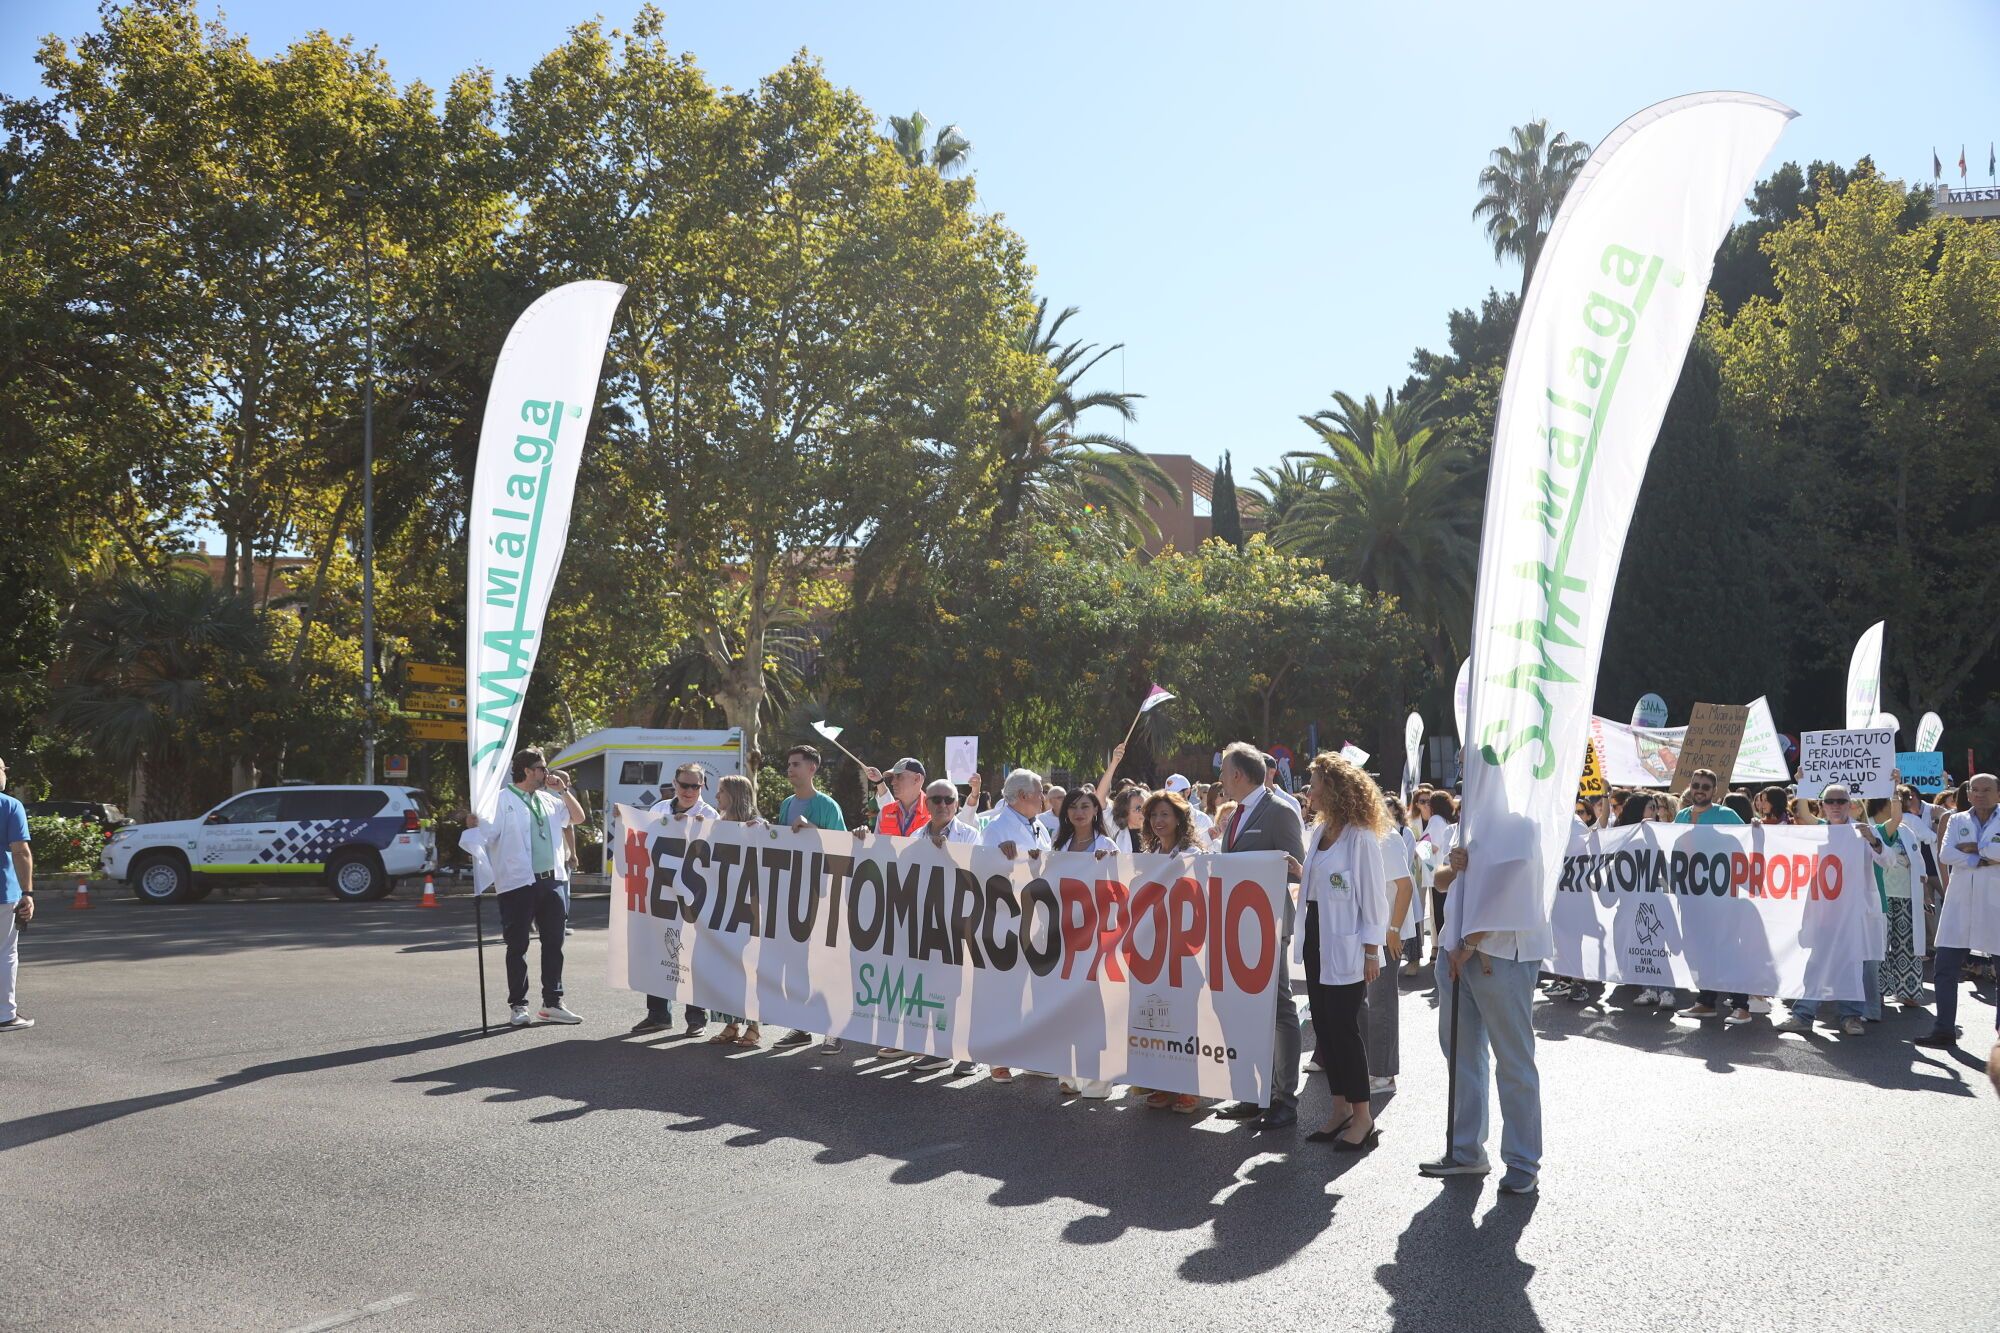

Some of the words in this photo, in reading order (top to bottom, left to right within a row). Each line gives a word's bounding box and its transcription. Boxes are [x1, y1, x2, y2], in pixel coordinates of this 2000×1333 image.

[1522, 243, 1647, 539] Málaga
[486, 399, 556, 609] Málaga
[1805, 735, 1816, 745] EL
[1821, 732, 1892, 746] ESTATUTO
[1683, 751, 1716, 768] TRAJE
[1808, 748, 1872, 759] PERJUDICA
[1804, 757, 1881, 772] SERIAMENTE
[1810, 774, 1823, 783] LA
[1828, 771, 1877, 785] SALUD
[624, 827, 1276, 995] #ESTATUTOMARCOPROPIO
[1628, 946, 1672, 958] ASOCIACIÓN
[1640, 957, 1653, 966] MIR
[1634, 965, 1662, 975] ESPAÑA
[856, 962, 942, 1018] SMA
